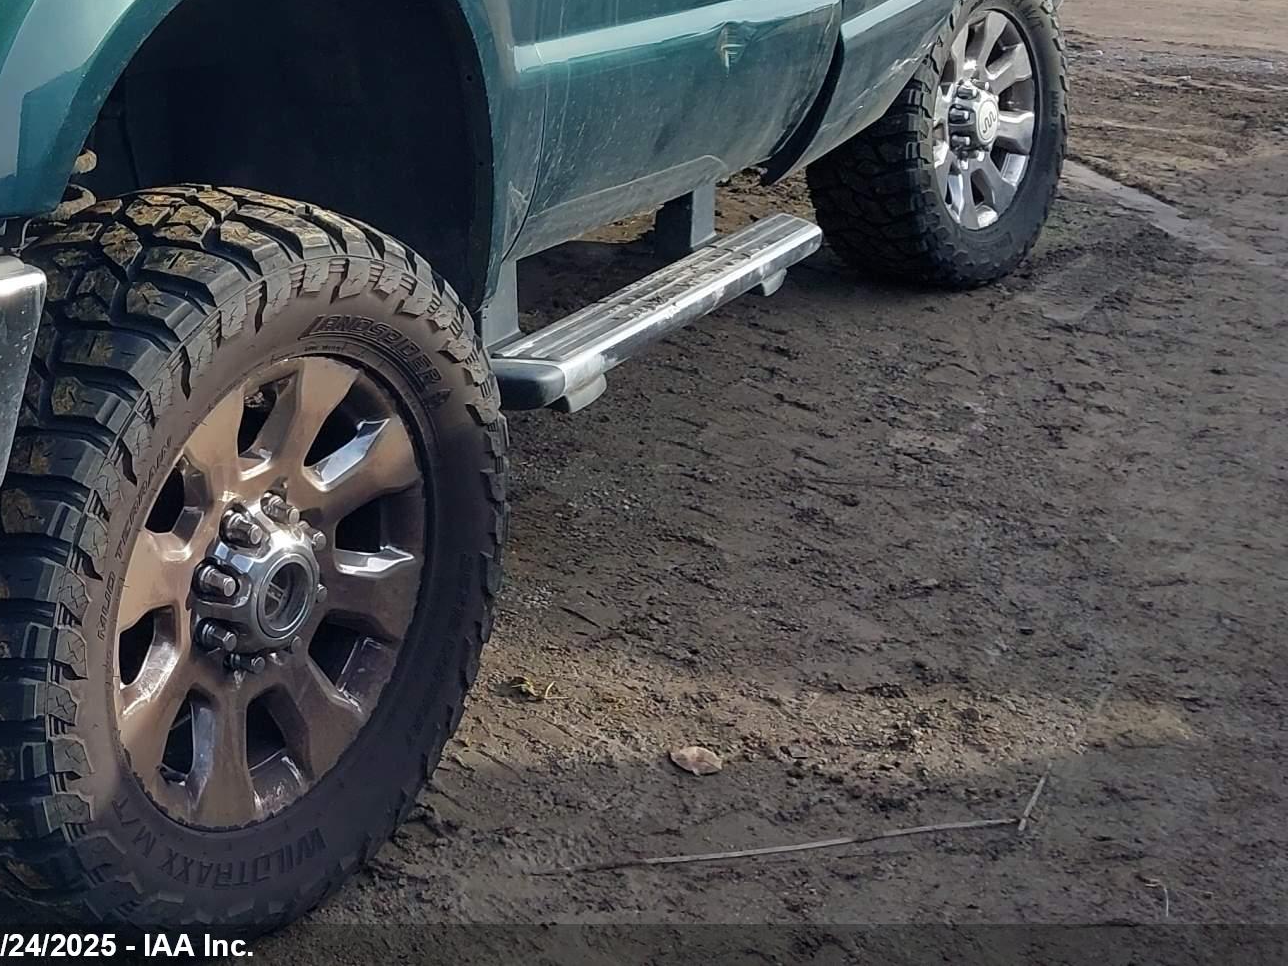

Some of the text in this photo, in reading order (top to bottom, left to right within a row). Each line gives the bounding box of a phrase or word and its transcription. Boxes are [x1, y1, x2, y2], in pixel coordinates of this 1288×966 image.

[97, 435, 172, 642] MUD TERRAIN
[158, 826, 328, 890] WILDTRAXX
